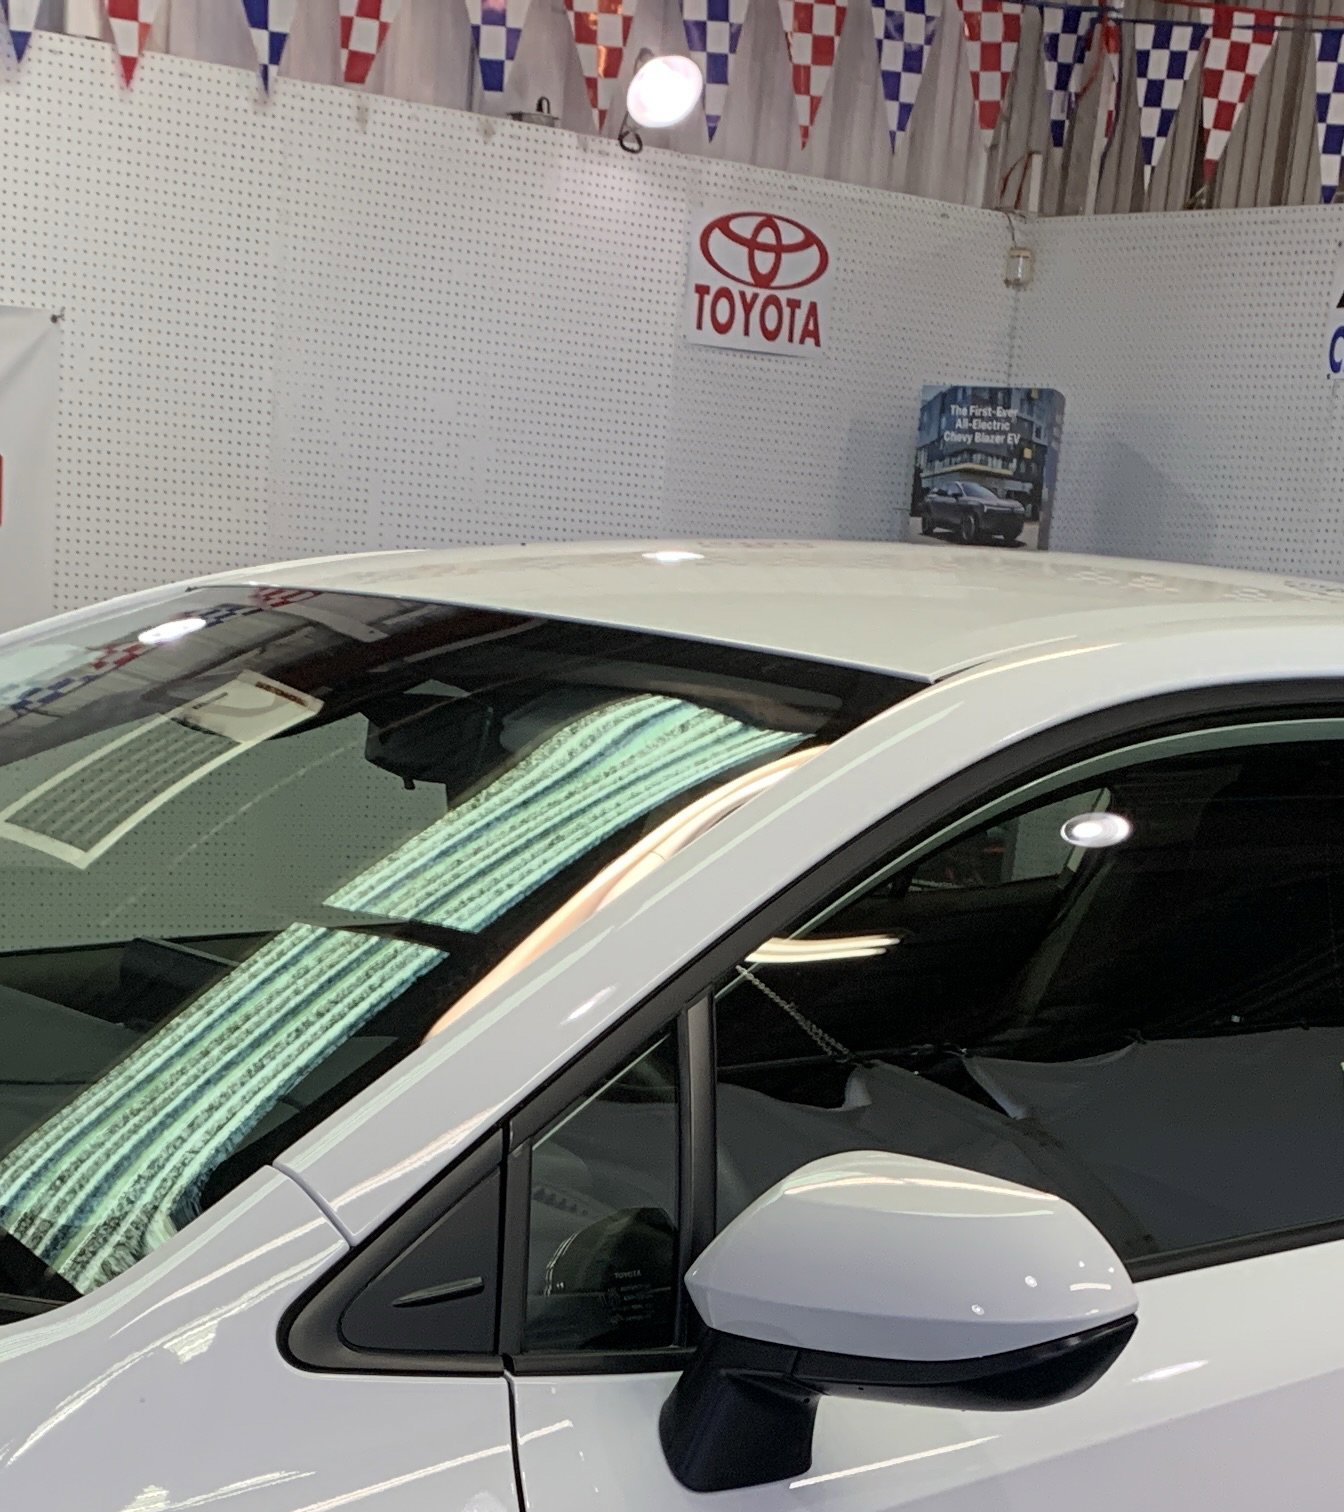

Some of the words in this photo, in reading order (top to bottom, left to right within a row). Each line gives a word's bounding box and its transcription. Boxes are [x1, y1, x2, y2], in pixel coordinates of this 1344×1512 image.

[694, 283, 821, 348] TOYOTA
[950, 404, 968, 416] The
[969, 404, 1019, 418] First-Ever
[955, 418, 1011, 431] All-Electric
[943, 431, 974, 445] Chevy
[974, 431, 1006, 445] Blazer
[1006, 432, 1022, 445] EV
